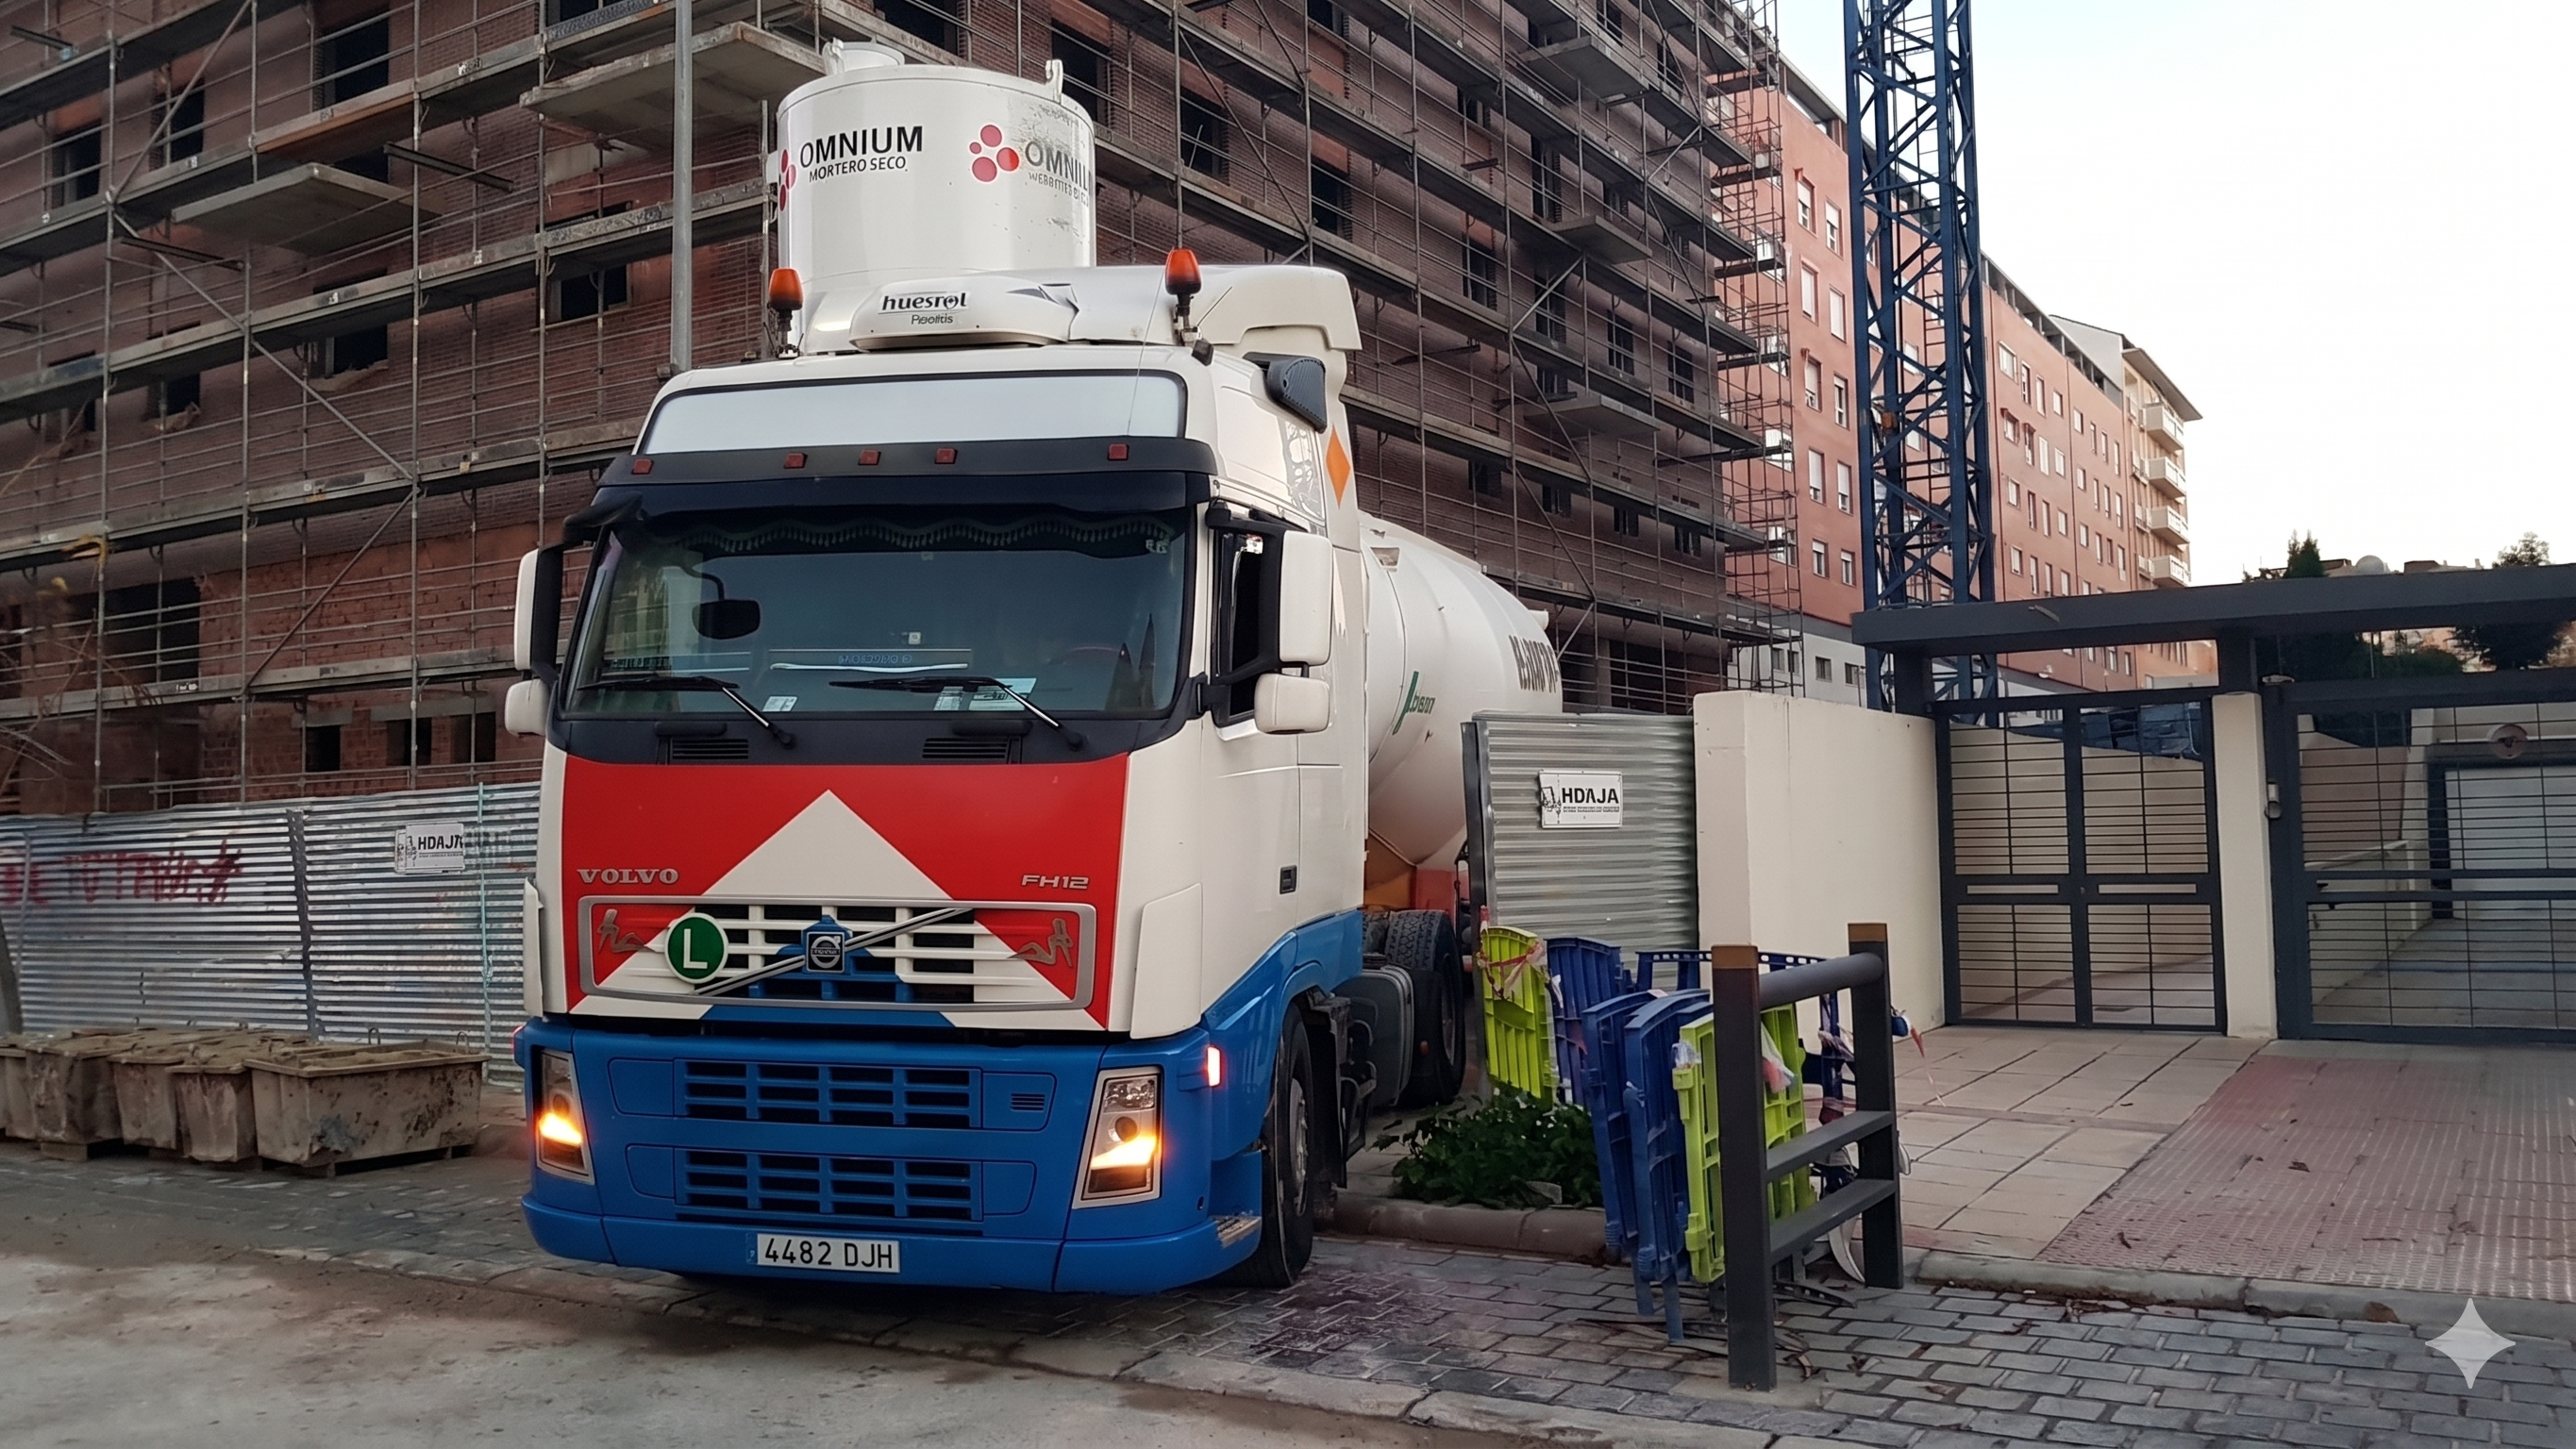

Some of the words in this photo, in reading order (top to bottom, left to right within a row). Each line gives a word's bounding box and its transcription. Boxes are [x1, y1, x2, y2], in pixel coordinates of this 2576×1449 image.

[800, 125, 923, 168] OMNIUM
[809, 158, 867, 183] MORTERO
[1562, 787, 1619, 804] HDAJA
[577, 868, 678, 884] VOLVO
[1021, 874, 1089, 890] FH12
[683, 928, 708, 969] L
[765, 1238, 831, 1265] 4482
[845, 1242, 892, 1269] DJH
